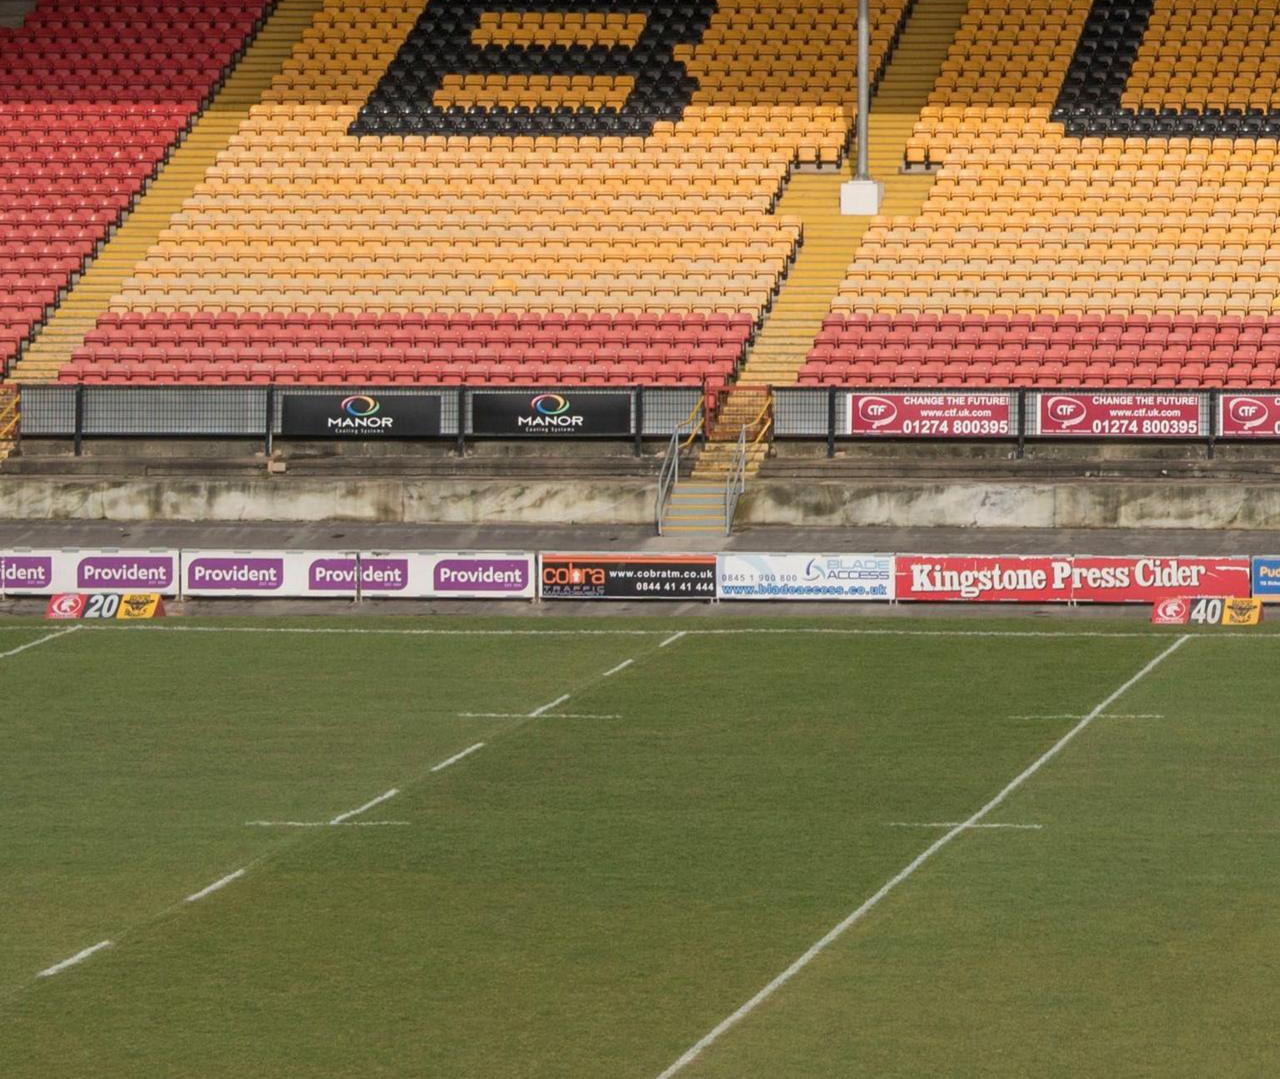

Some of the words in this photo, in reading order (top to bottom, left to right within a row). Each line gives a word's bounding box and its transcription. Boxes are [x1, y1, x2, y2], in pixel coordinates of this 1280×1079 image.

[903, 396, 945, 405] CHANGE
[947, 396, 968, 405] THE
[969, 396, 1009, 405] FUTURE!
[1092, 396, 1133, 405] CHANGE
[1135, 396, 1156, 405] THE
[1157, 396, 1198, 405] FUTURE!
[920, 408, 991, 418] www.ctf.uk.com
[1109, 408, 1181, 418] www.ctf.uk.com
[328, 417, 394, 427] MANOR
[518, 415, 583, 426] MANOR
[903, 420, 949, 434] 01274
[951, 420, 1008, 434] 800395
[1092, 420, 1138, 434] 01274
[1141, 420, 1197, 434] 800395
[826, 559, 890, 569] BLADE
[0, 563, 46, 580] ident
[84, 563, 167, 581] Provident
[194, 565, 277, 583] Provident
[315, 566, 402, 582] Provident
[440, 566, 523, 584] Provident
[543, 562, 606, 585] cobra
[609, 569, 713, 579] www.cobratm.co.uk
[826, 570, 890, 580] ACCESS
[910, 560, 1047, 597] Kingstone
[1052, 561, 1131, 589] Press
[1134, 558, 1206, 588] Cider
[721, 574, 746, 582] 0845
[750, 574, 754, 582] 1
[758, 574, 776, 582] 900
[780, 574, 798, 582] 800
[636, 582, 662, 591] 0844
[663, 582, 676, 591] 41
[678, 582, 690, 591] 41
[693, 582, 714, 591] 444
[721, 583, 887, 595] www.bladeaccess.co.uk
[84, 594, 119, 618] 20
[1190, 599, 1222, 624] 40
